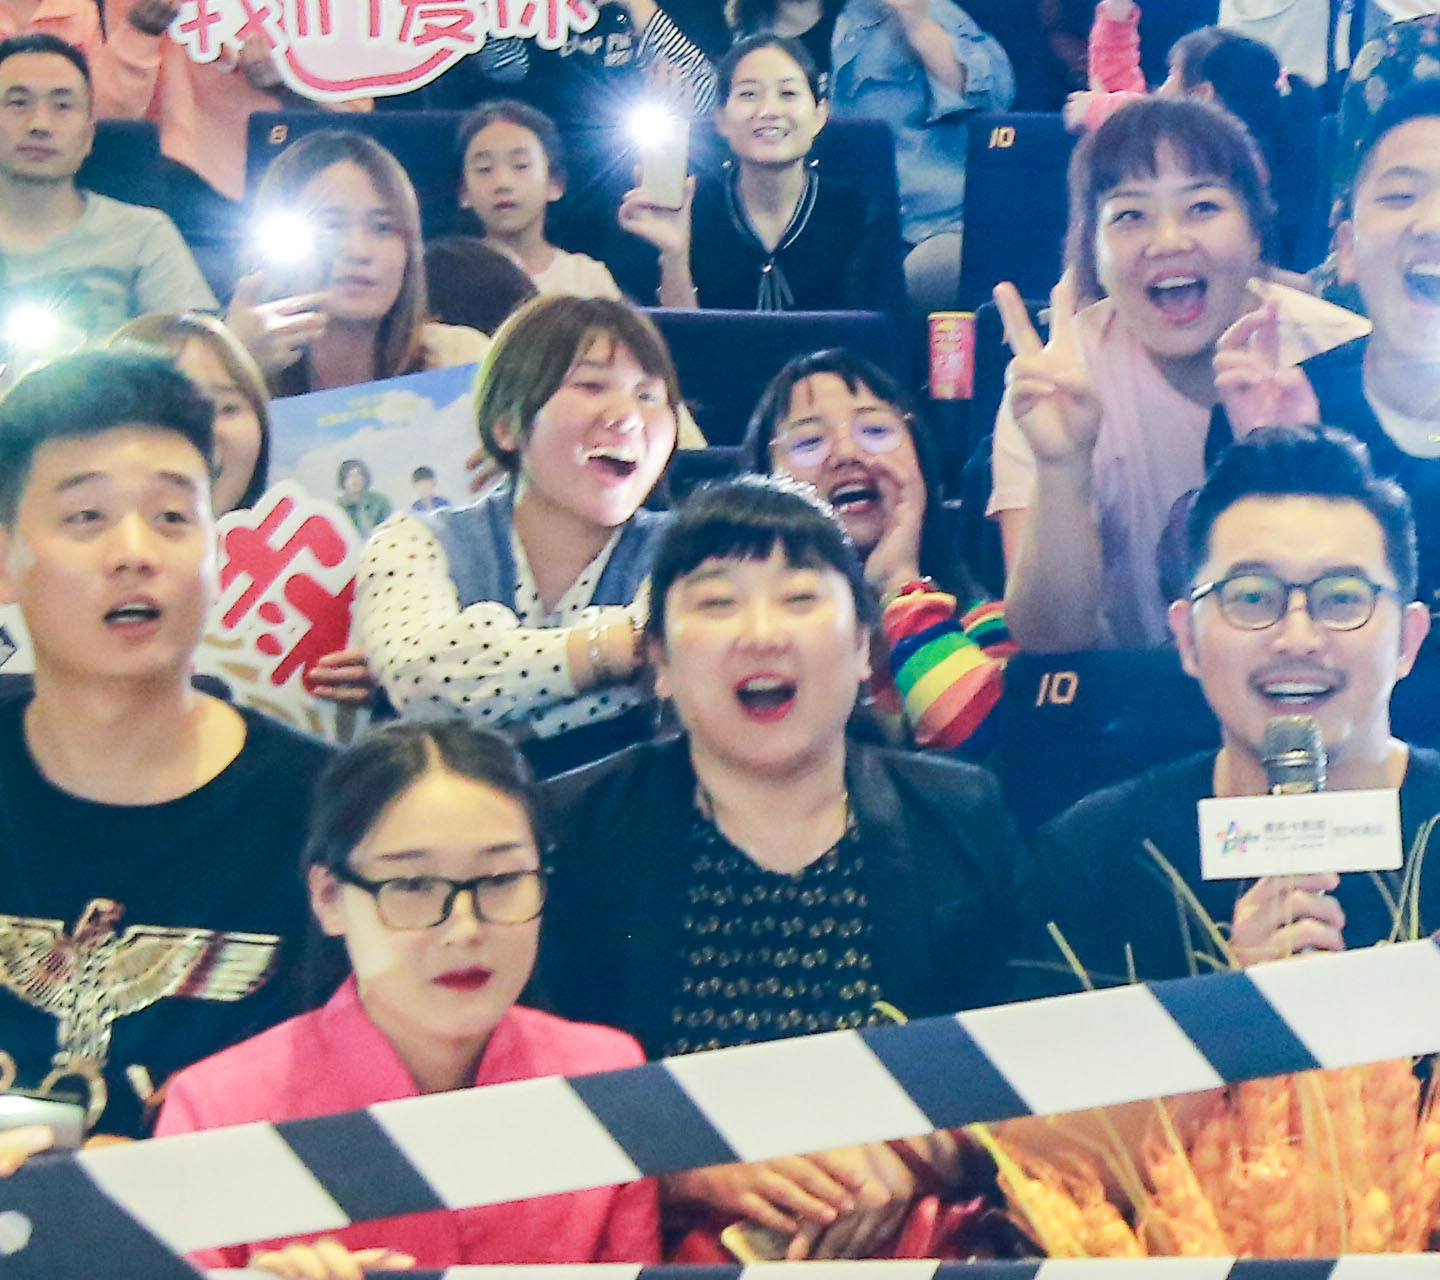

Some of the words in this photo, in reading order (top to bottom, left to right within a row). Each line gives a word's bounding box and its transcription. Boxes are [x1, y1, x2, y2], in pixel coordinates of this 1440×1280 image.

[269, 124, 289, 145] 8
[988, 126, 1016, 149] 10
[1036, 670, 1079, 707] 10
